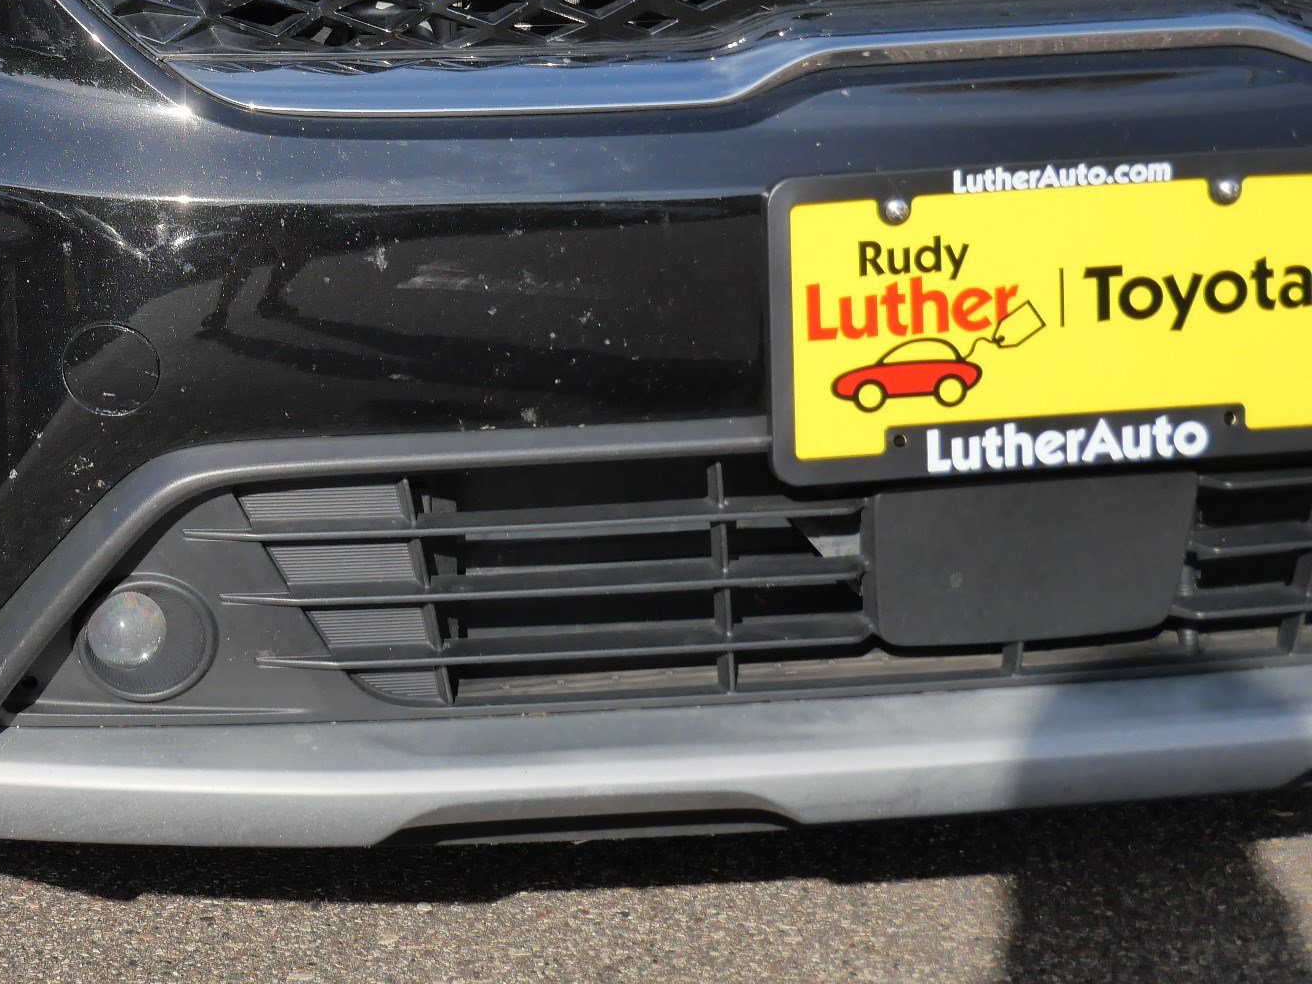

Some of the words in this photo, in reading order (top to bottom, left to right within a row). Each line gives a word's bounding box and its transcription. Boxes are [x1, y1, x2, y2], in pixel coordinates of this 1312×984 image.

[953, 161, 1172, 194] LutherAuto.com
[858, 235, 969, 280] Rudy
[806, 277, 1018, 341] Luther
[1084, 256, 1312, 330] Toyota
[926, 416, 1209, 474] LutherAuto
